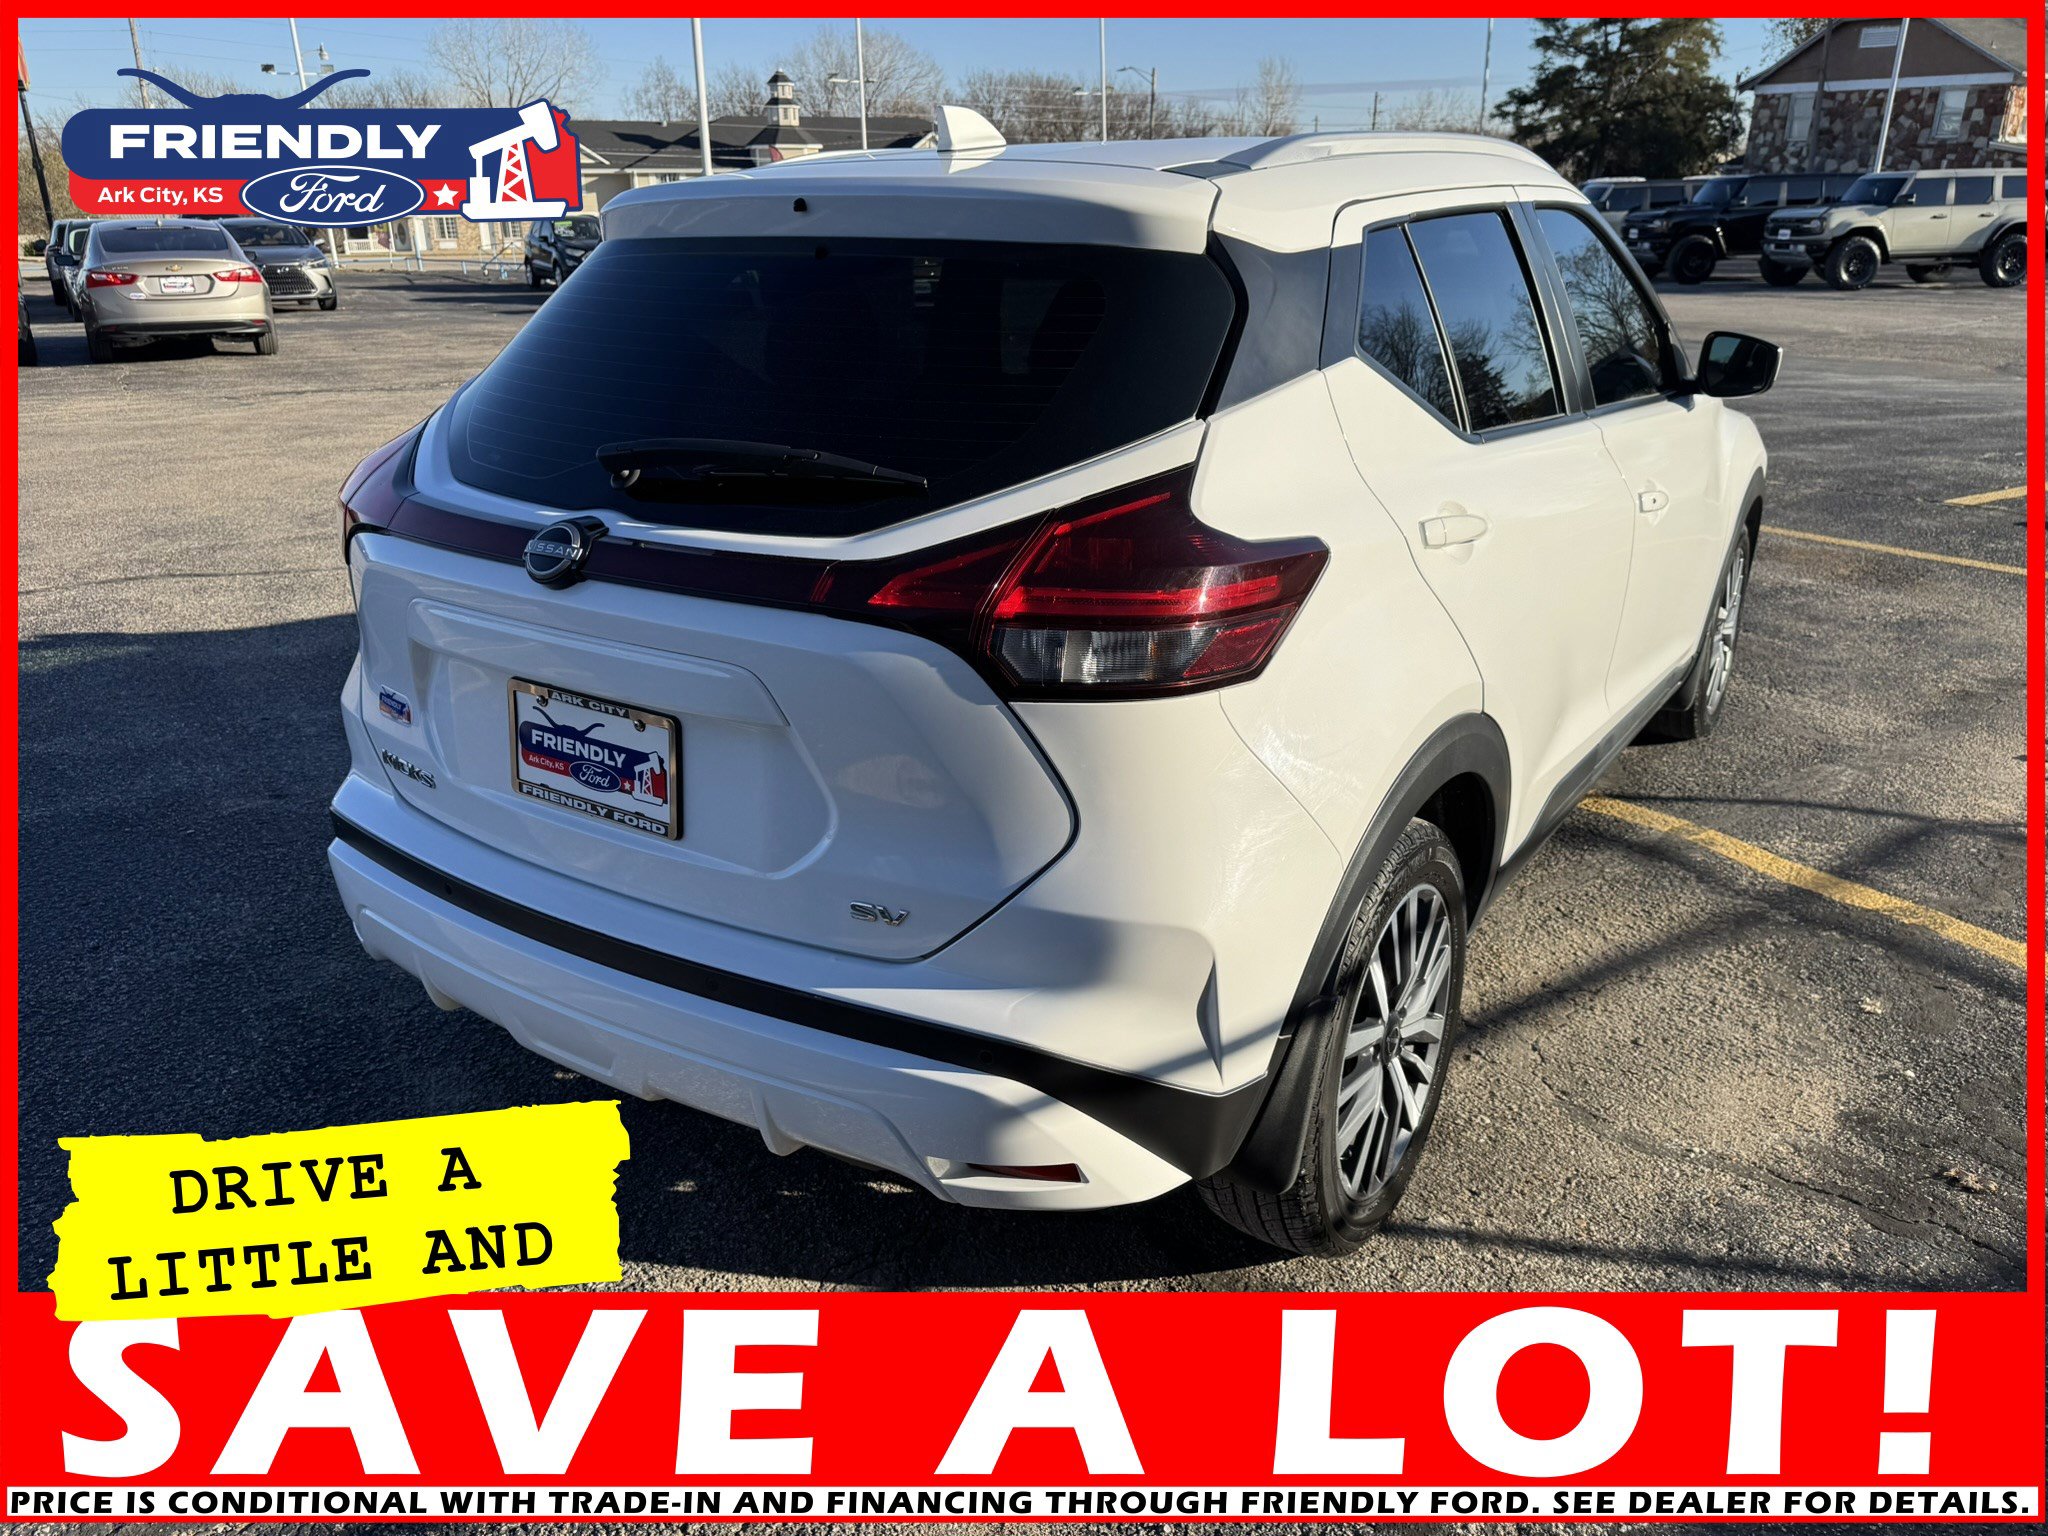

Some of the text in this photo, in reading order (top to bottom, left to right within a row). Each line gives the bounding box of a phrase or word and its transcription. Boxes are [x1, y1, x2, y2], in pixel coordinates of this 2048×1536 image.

[526, 540, 578, 559] NISSAN
[551, 691, 626, 717] ARK CITY
[531, 729, 627, 769] FRIENDLY
[528, 754, 540, 763] Ark
[555, 761, 565, 771] KS
[579, 764, 610, 787] Ford
[522, 784, 666, 835] FRIENDLY FORD
[850, 901, 910, 927] SV
